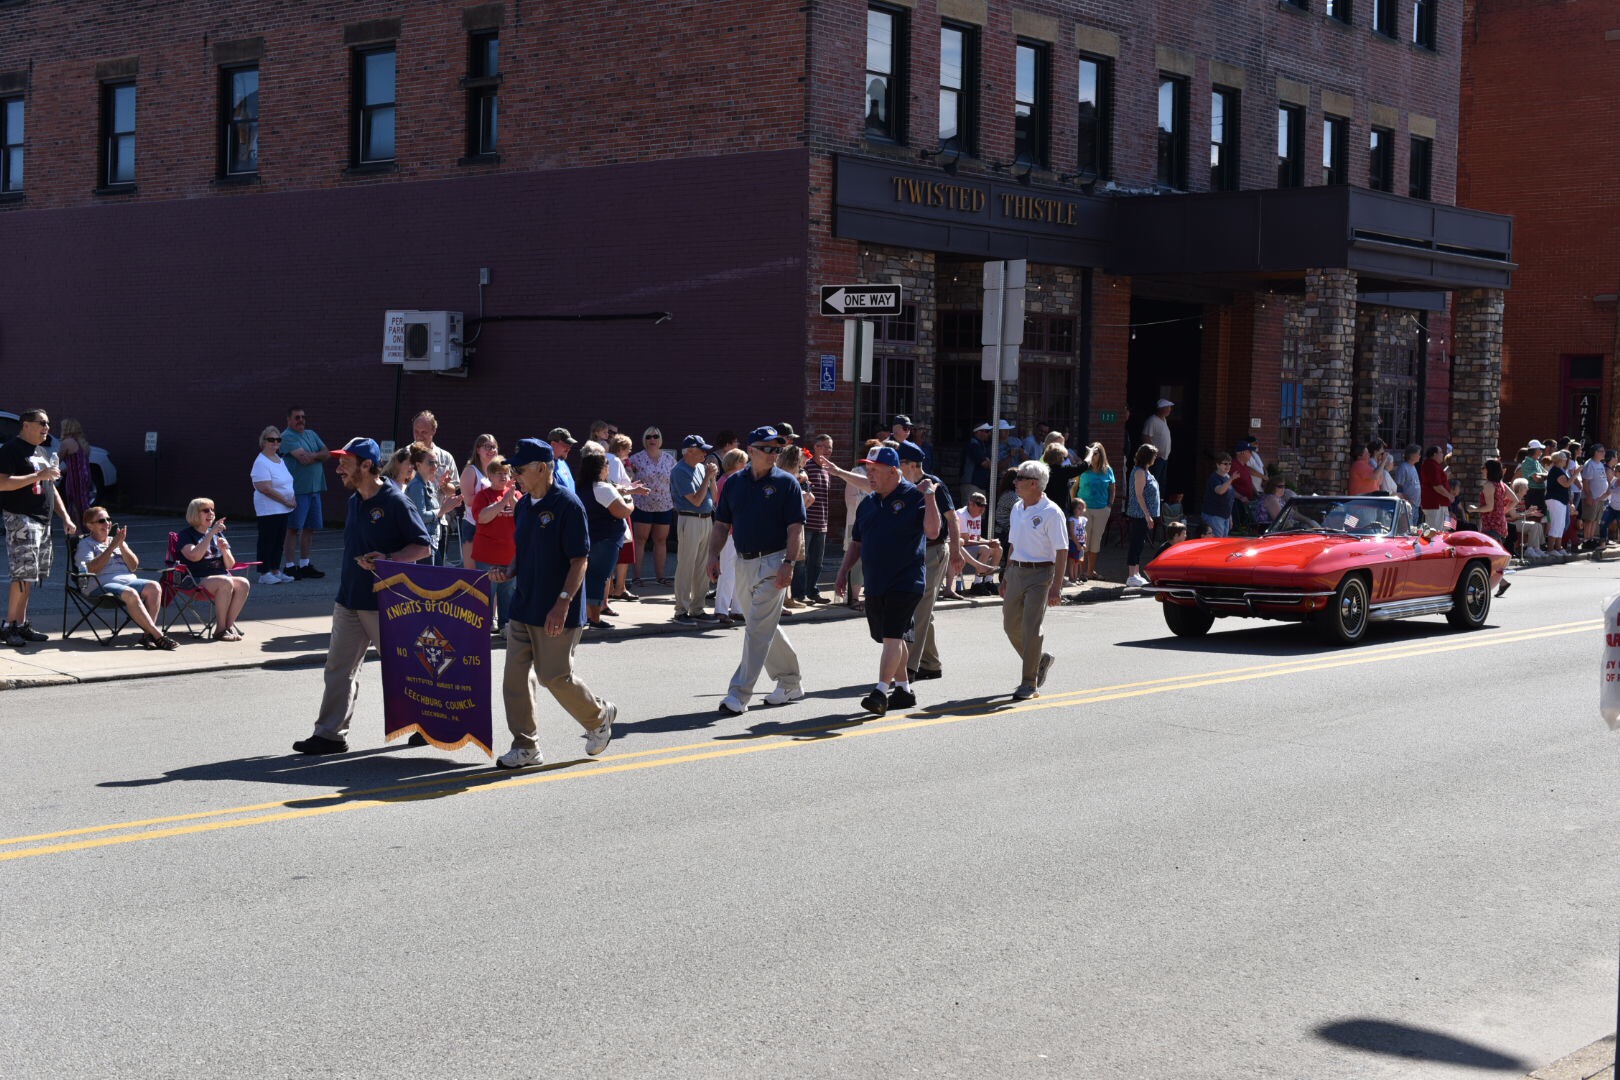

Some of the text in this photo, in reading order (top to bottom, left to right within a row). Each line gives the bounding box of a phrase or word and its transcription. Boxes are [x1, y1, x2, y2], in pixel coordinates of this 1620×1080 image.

[892, 176, 1078, 225] TWISTED THISTLE
[844, 294, 892, 306] ONE WAY
[385, 600, 484, 629] KNIGHTS OF COLUMBUS
[396, 646, 408, 657] NO
[463, 656, 481, 666] 6715
[404, 687, 476, 710] LEECHBURG COUNCIL
